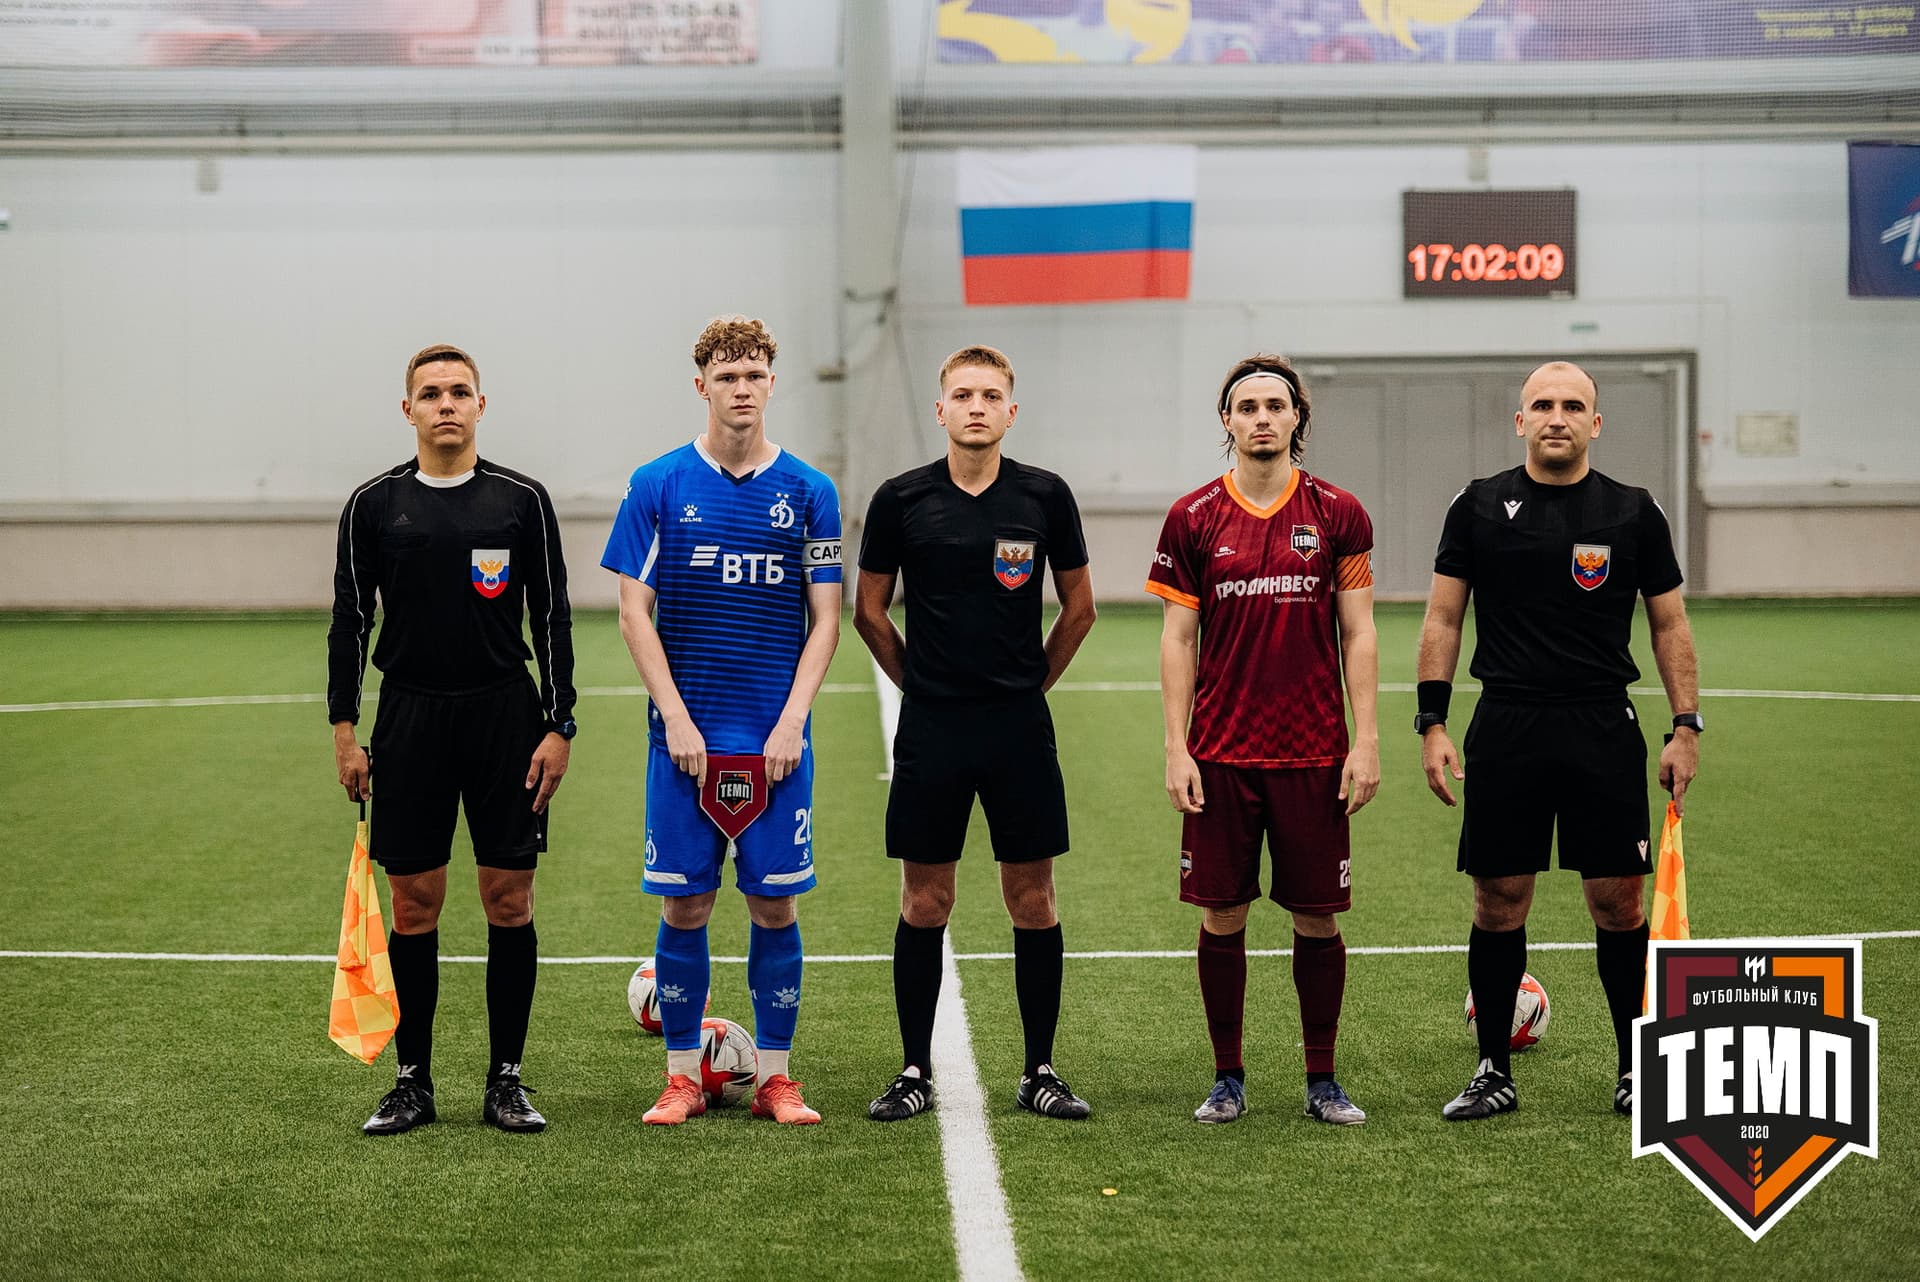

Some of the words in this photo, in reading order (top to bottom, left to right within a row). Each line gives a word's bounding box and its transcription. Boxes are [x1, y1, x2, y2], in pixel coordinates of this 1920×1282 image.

[1408, 243, 1564, 282] 17:02:09
[1293, 534, 1317, 549] ТЕМП
[722, 553, 785, 585] ВТБ
[720, 783, 750, 799] ТЕМП
